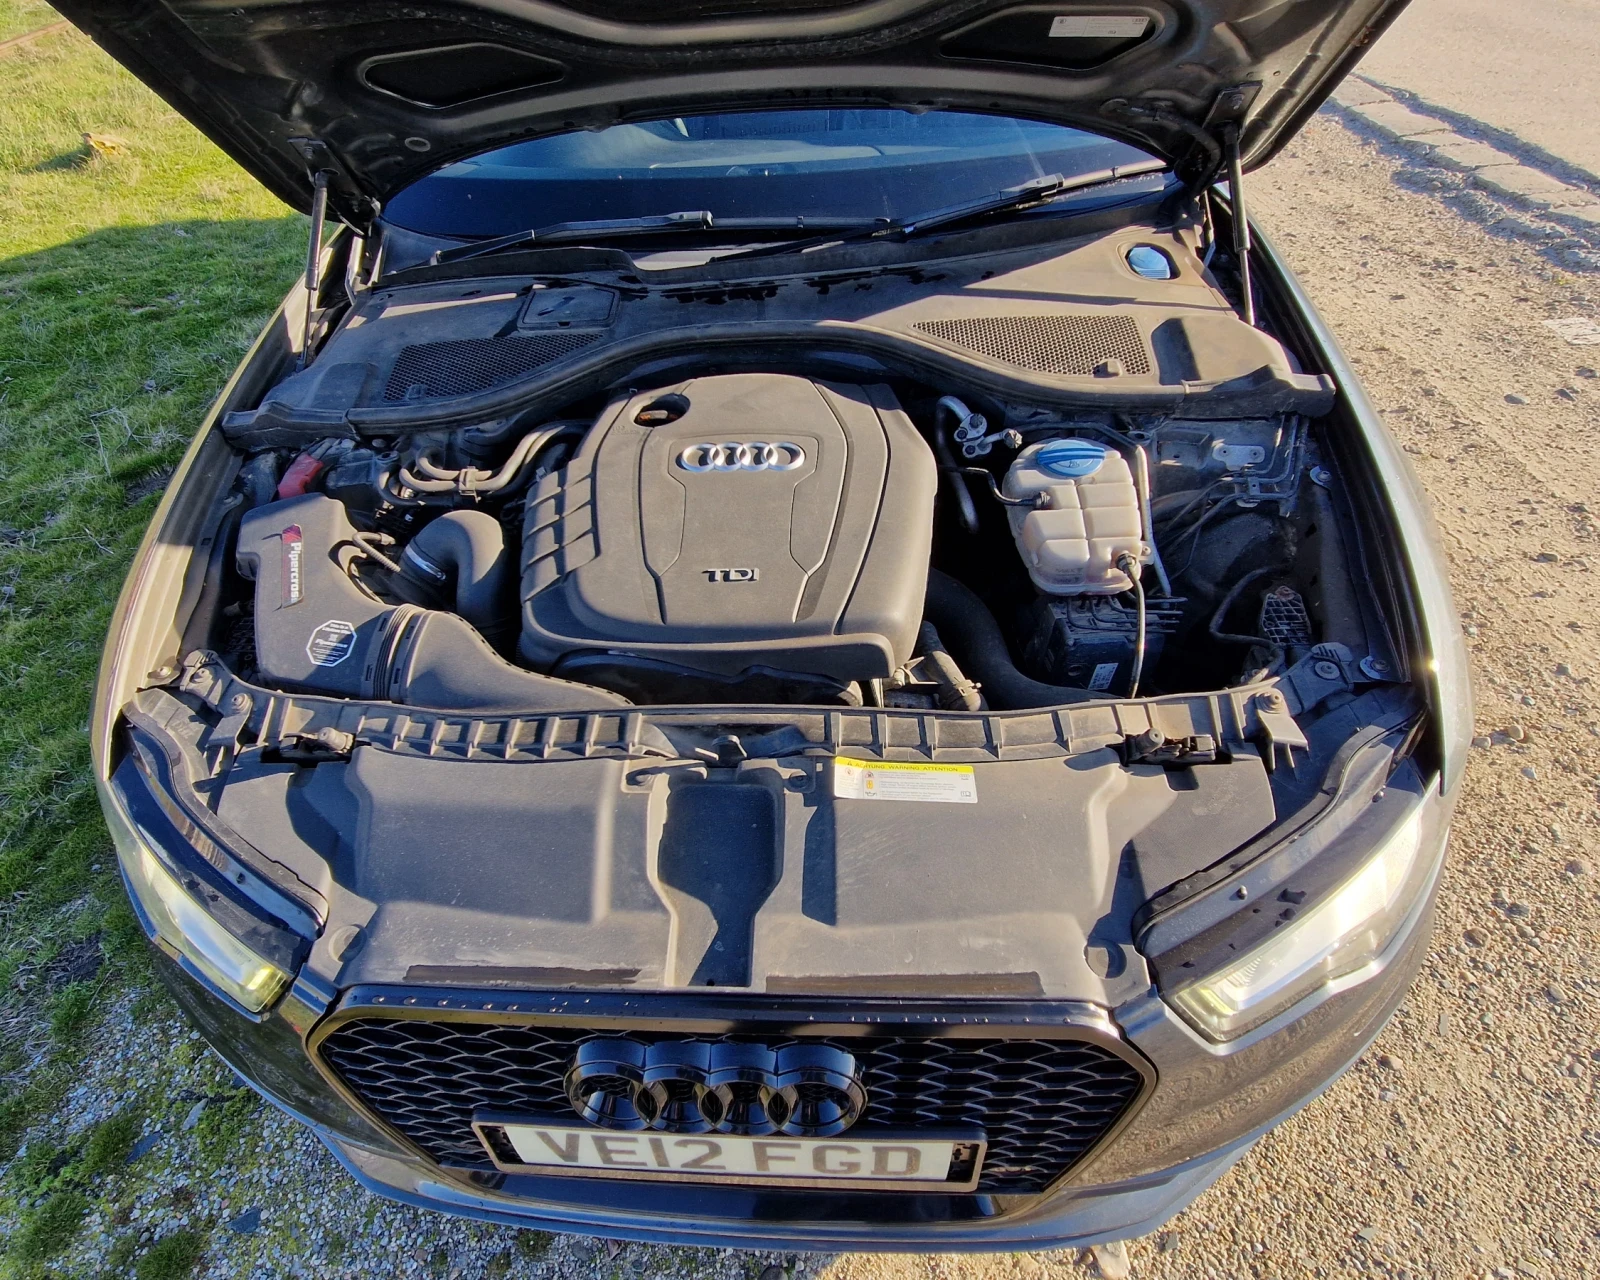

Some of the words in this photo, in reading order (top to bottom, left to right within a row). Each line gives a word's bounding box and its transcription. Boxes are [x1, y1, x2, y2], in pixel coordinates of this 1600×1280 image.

[704, 567, 760, 582] TDI
[535, 1130, 727, 1171] VE12
[750, 1141, 923, 1176] FGD
